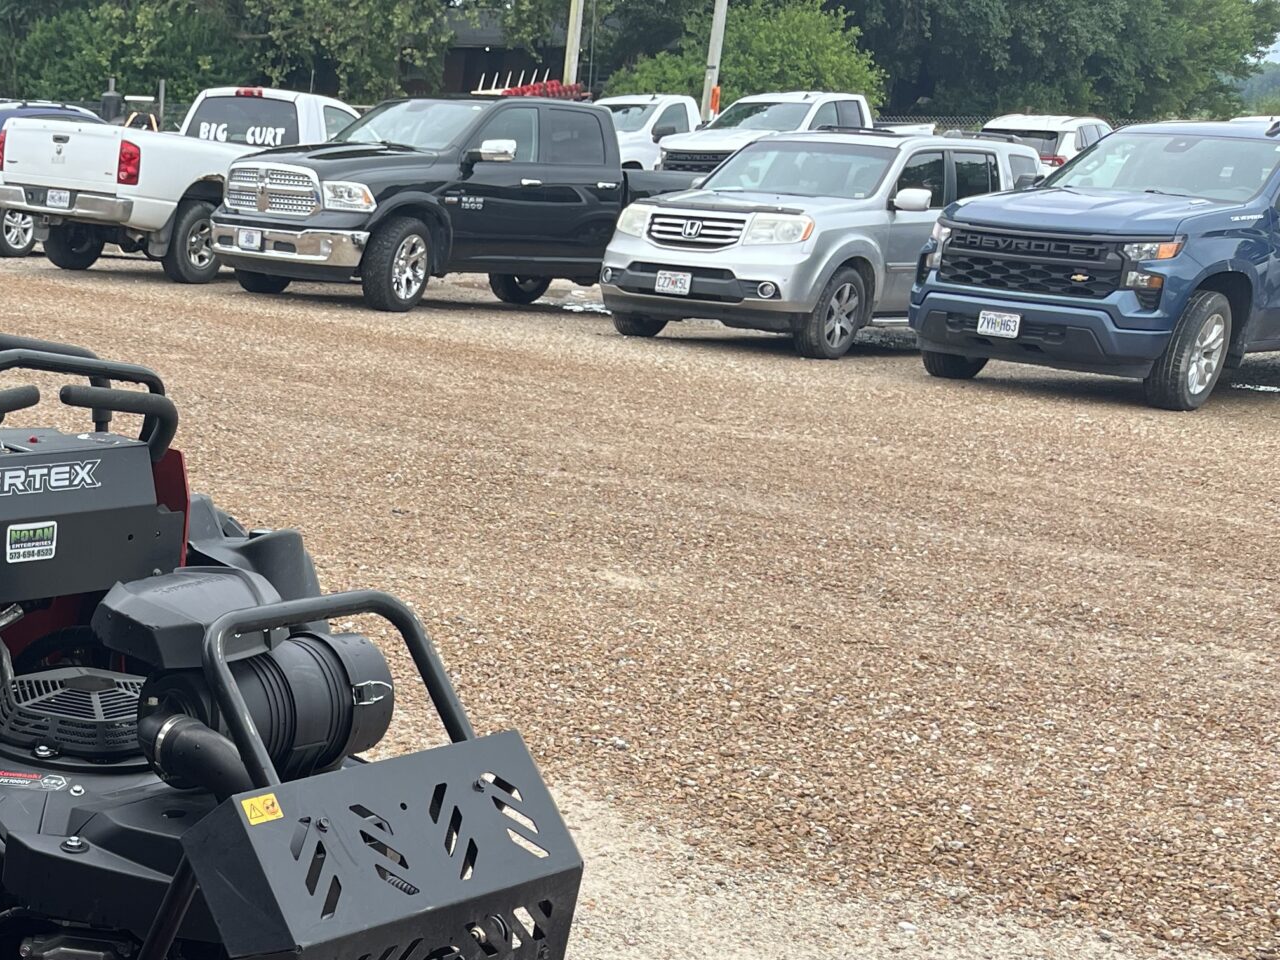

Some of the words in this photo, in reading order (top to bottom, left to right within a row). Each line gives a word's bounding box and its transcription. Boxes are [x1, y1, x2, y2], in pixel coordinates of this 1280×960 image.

[200, 122, 228, 142] BIG
[246, 126, 285, 146] CURT
[952, 234, 1106, 257] CHEVROLET
[11, 527, 53, 543] NOLAN
[12, 541, 52, 549] ENTERPRISES
